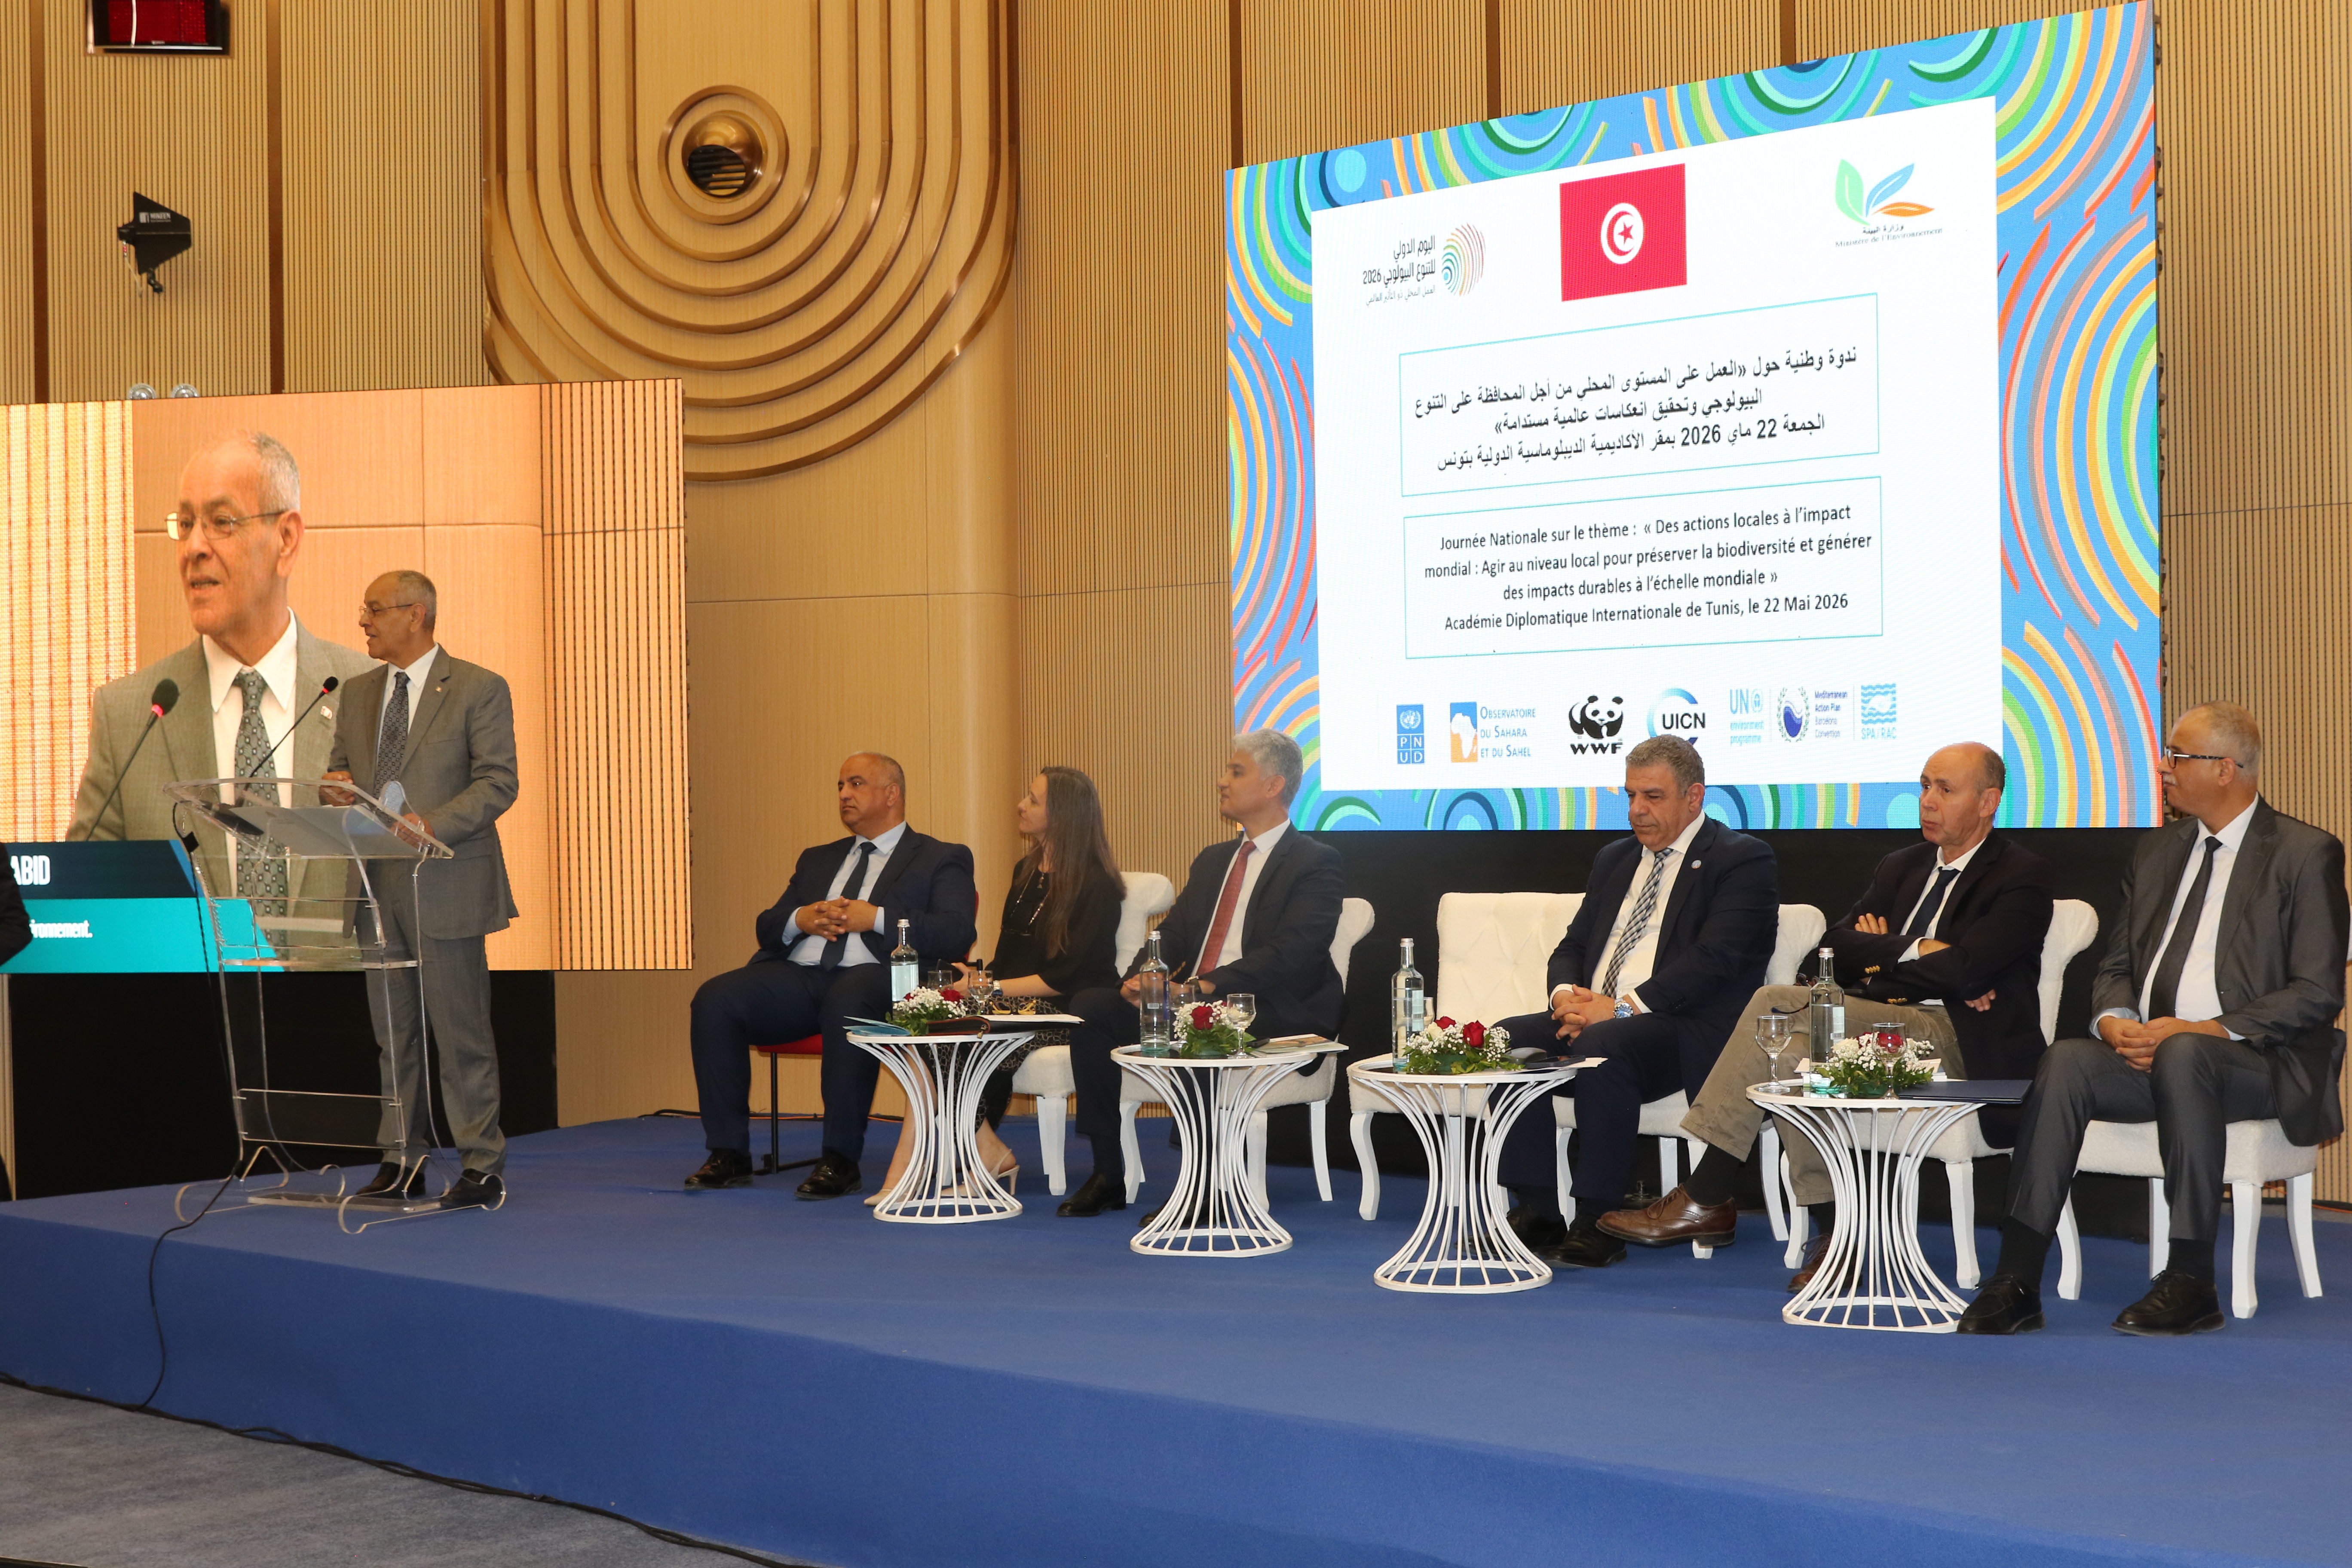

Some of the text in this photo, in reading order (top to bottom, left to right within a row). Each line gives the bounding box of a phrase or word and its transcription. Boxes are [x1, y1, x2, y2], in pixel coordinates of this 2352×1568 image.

[1393, 235, 1435, 263] اليوم الدولي
[1363, 259, 1435, 288] للتنوع البيولوجي 2026
[1753, 356, 1779, 377] حول
[1785, 350, 1822, 372] وطنية
[1829, 346, 1856, 368] ندوة
[1577, 374, 1614, 399] المحلي
[1621, 368, 1670, 392] المستوى
[1676, 364, 1699, 388] على
[1478, 385, 1525, 404] المحافظة
[1530, 378, 1550, 401] أجل
[1556, 383, 1571, 398] من
[1415, 393, 1446, 417] التنوع
[1452, 390, 1472, 413] على
[1595, 401, 1647, 421] انعكاسات
[1652, 397, 1697, 420] وتحقيق
[1702, 387, 1762, 416] البيولوجي
[1554, 406, 1589, 429] عالمية
[1757, 419, 1777, 438] 22
[1783, 412, 1824, 435] الجمعة
[1651, 430, 1675, 451] بمقر
[1681, 424, 1721, 446] 2026
[1728, 423, 1751, 445] ماي
[1438, 450, 1473, 470] بتونس
[1477, 444, 1513, 467] الدولية
[1518, 437, 1585, 463] الديبلوماسية
[1440, 533, 1486, 551] Journée
[1490, 528, 1547, 547] Nationale
[1551, 529, 1570, 542] sur
[1574, 525, 1584, 539] le
[1589, 522, 1629, 538] thème
[1656, 520, 1679, 534] Des
[1683, 515, 1730, 531] actions
[1733, 510, 1779, 528] locales
[1783, 508, 1791, 524] à
[1425, 560, 1471, 578] mondial
[1482, 560, 1505, 577] Agir
[1509, 561, 1523, 573] au
[1527, 556, 1567, 571] niveau
[1571, 551, 1600, 568] local
[1604, 553, 1632, 570] pour
[1637, 546, 1697, 567] préserver
[1702, 543, 1712, 559] la
[1717, 537, 1795, 558] biodiversité
[1800, 537, 1813, 551] et
[1818, 533, 1872, 555] générer
[1504, 585, 1523, 600] des
[1527, 582, 1574, 601] impacts
[1578, 578, 1632, 596] durables
[1636, 576, 1643, 591] à
[1703, 569, 1765, 587] mondiale
[1446, 594, 1848, 631] Académie Diplomatique Internationale de Tunis, le 22 Mai 2026
[1730, 689, 1749, 714] UN
[1480, 726, 1528, 738] DU SAHARA
[1662, 712, 1706, 730] UICN
[1481, 744, 1531, 758] ET DU SAHEL
[1570, 742, 1623, 754] WWF
[29, 919, 93, 938] ironnement.
